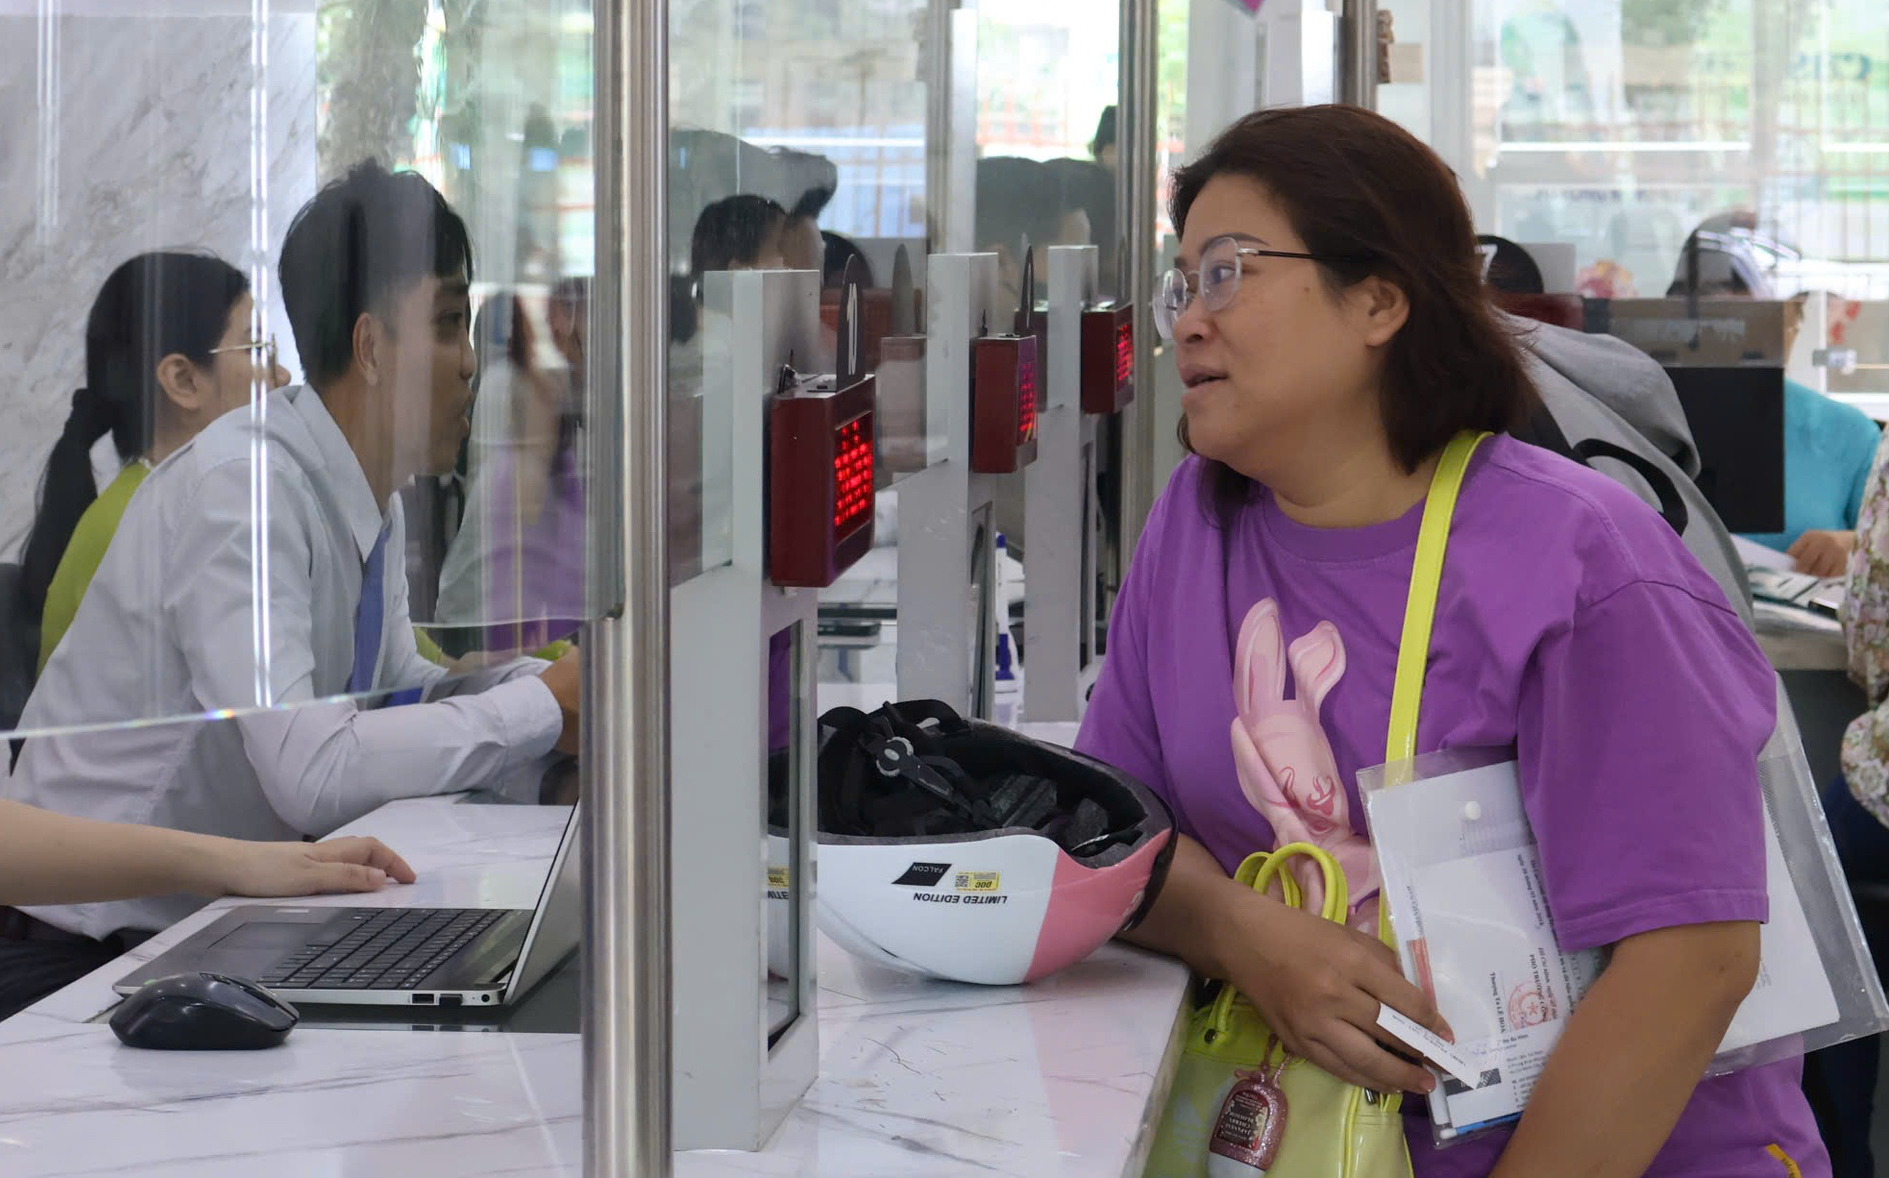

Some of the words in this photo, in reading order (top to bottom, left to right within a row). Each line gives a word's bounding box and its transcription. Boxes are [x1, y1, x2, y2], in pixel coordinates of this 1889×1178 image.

[913, 865, 944, 873] FALCON
[914, 893, 960, 903] EDITION
[963, 895, 1007, 904] LIMITED
[1229, 1118, 1251, 1128] CHERRY
